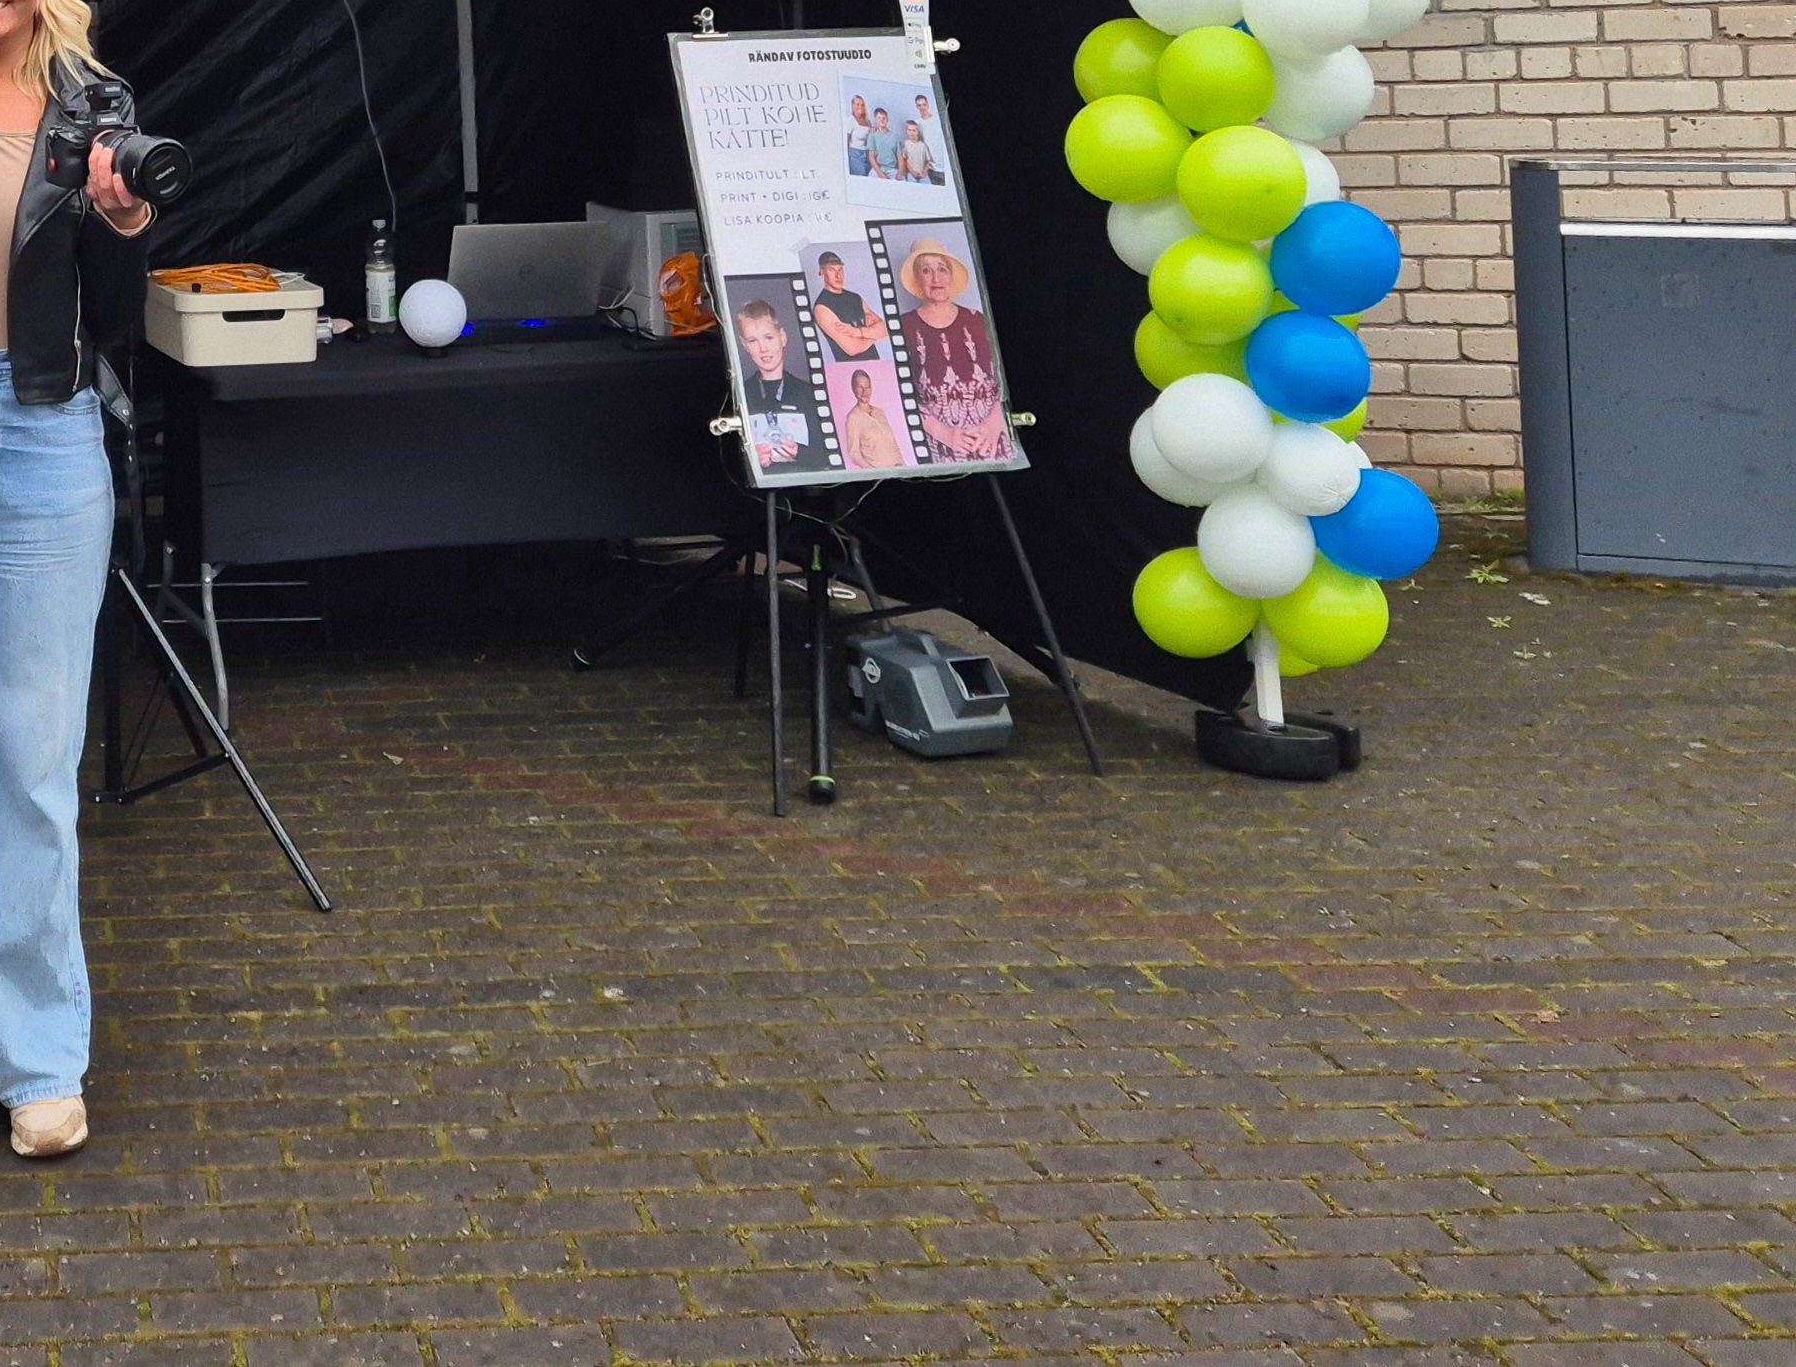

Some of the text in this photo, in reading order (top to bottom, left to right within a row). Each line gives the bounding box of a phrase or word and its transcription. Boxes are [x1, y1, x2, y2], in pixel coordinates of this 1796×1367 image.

[904, 5, 924, 13] VISA
[748, 49, 872, 63] RÄNDAV FOTOSTUUDIO
[700, 83, 820, 104] PRINDITUD
[705, 105, 827, 126] PILT KOHE
[721, 192, 756, 203] PRINT
[772, 191, 798, 202] DIGI
[724, 215, 751, 226] LISA
[756, 213, 804, 225] KOOPIA
